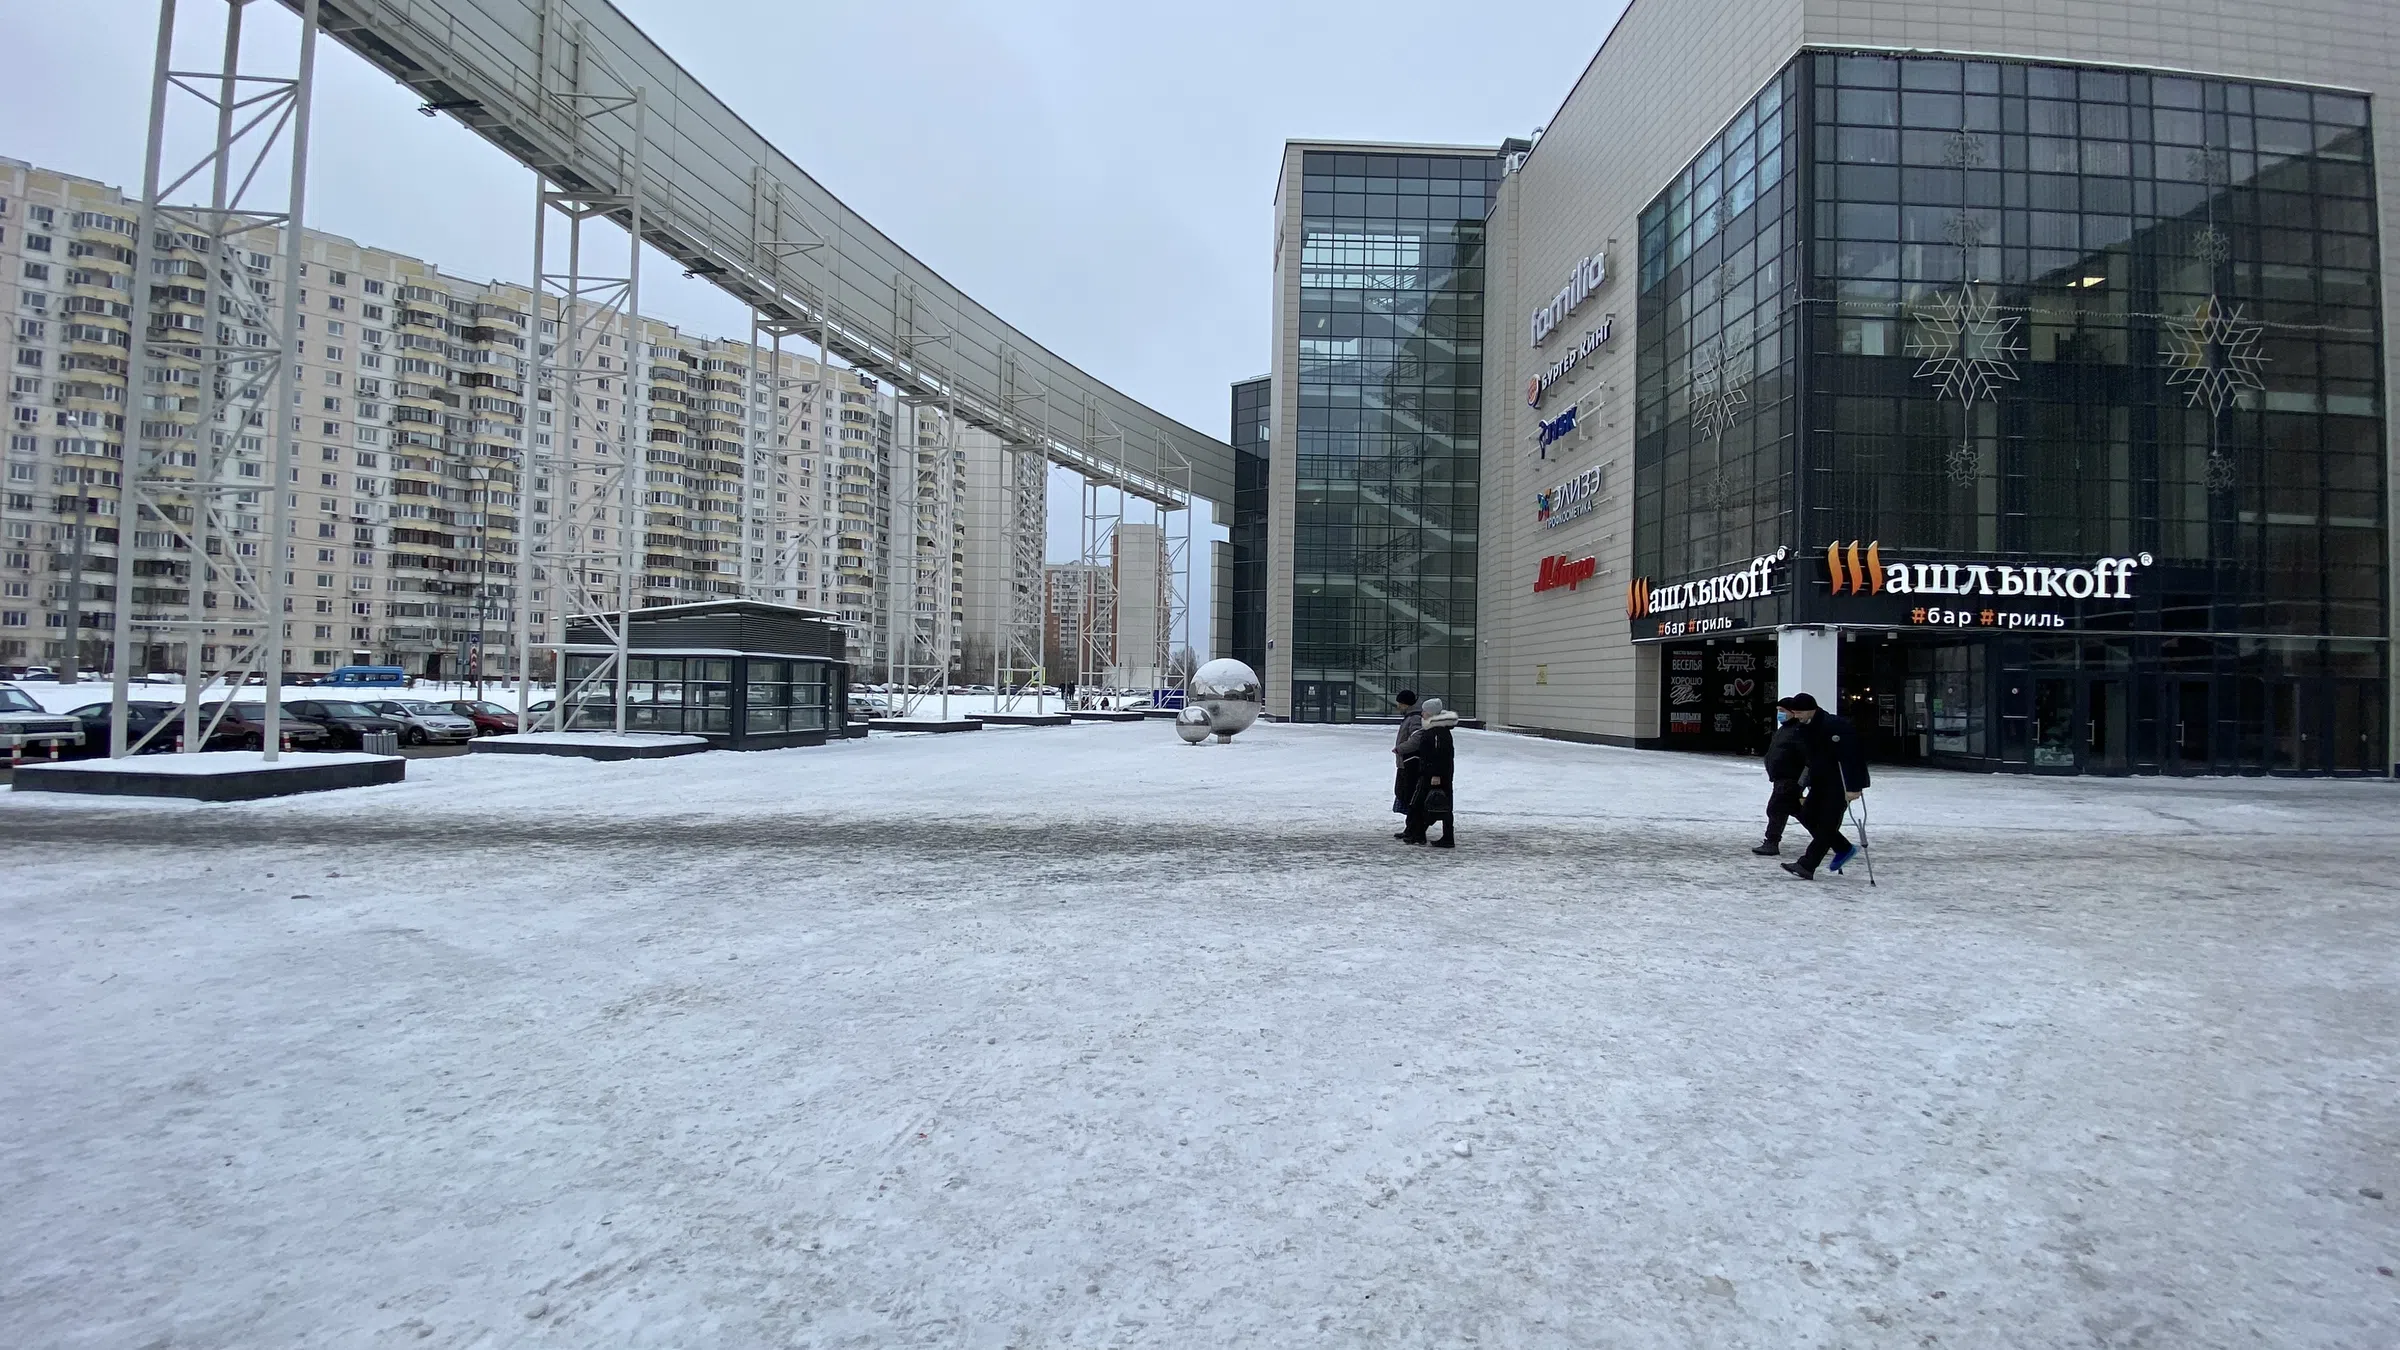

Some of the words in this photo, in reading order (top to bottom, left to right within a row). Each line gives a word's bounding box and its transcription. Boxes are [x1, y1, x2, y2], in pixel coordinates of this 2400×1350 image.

[1531, 252, 1606, 347] familia
[1541, 350, 1578, 389] БУРГЕР
[1579, 320, 1612, 361] КИНГ
[1552, 466, 1602, 512] ЭЛИЗЭ
[1658, 620, 1685, 636] #бар
[1688, 616, 1732, 633] #гриль
[1912, 607, 1972, 627] #бар
[1980, 608, 2065, 628] #гриль
[1672, 659, 1703, 671] ВЕСЕЛЬЯ
[1670, 676, 1703, 685] ХОРОШО
